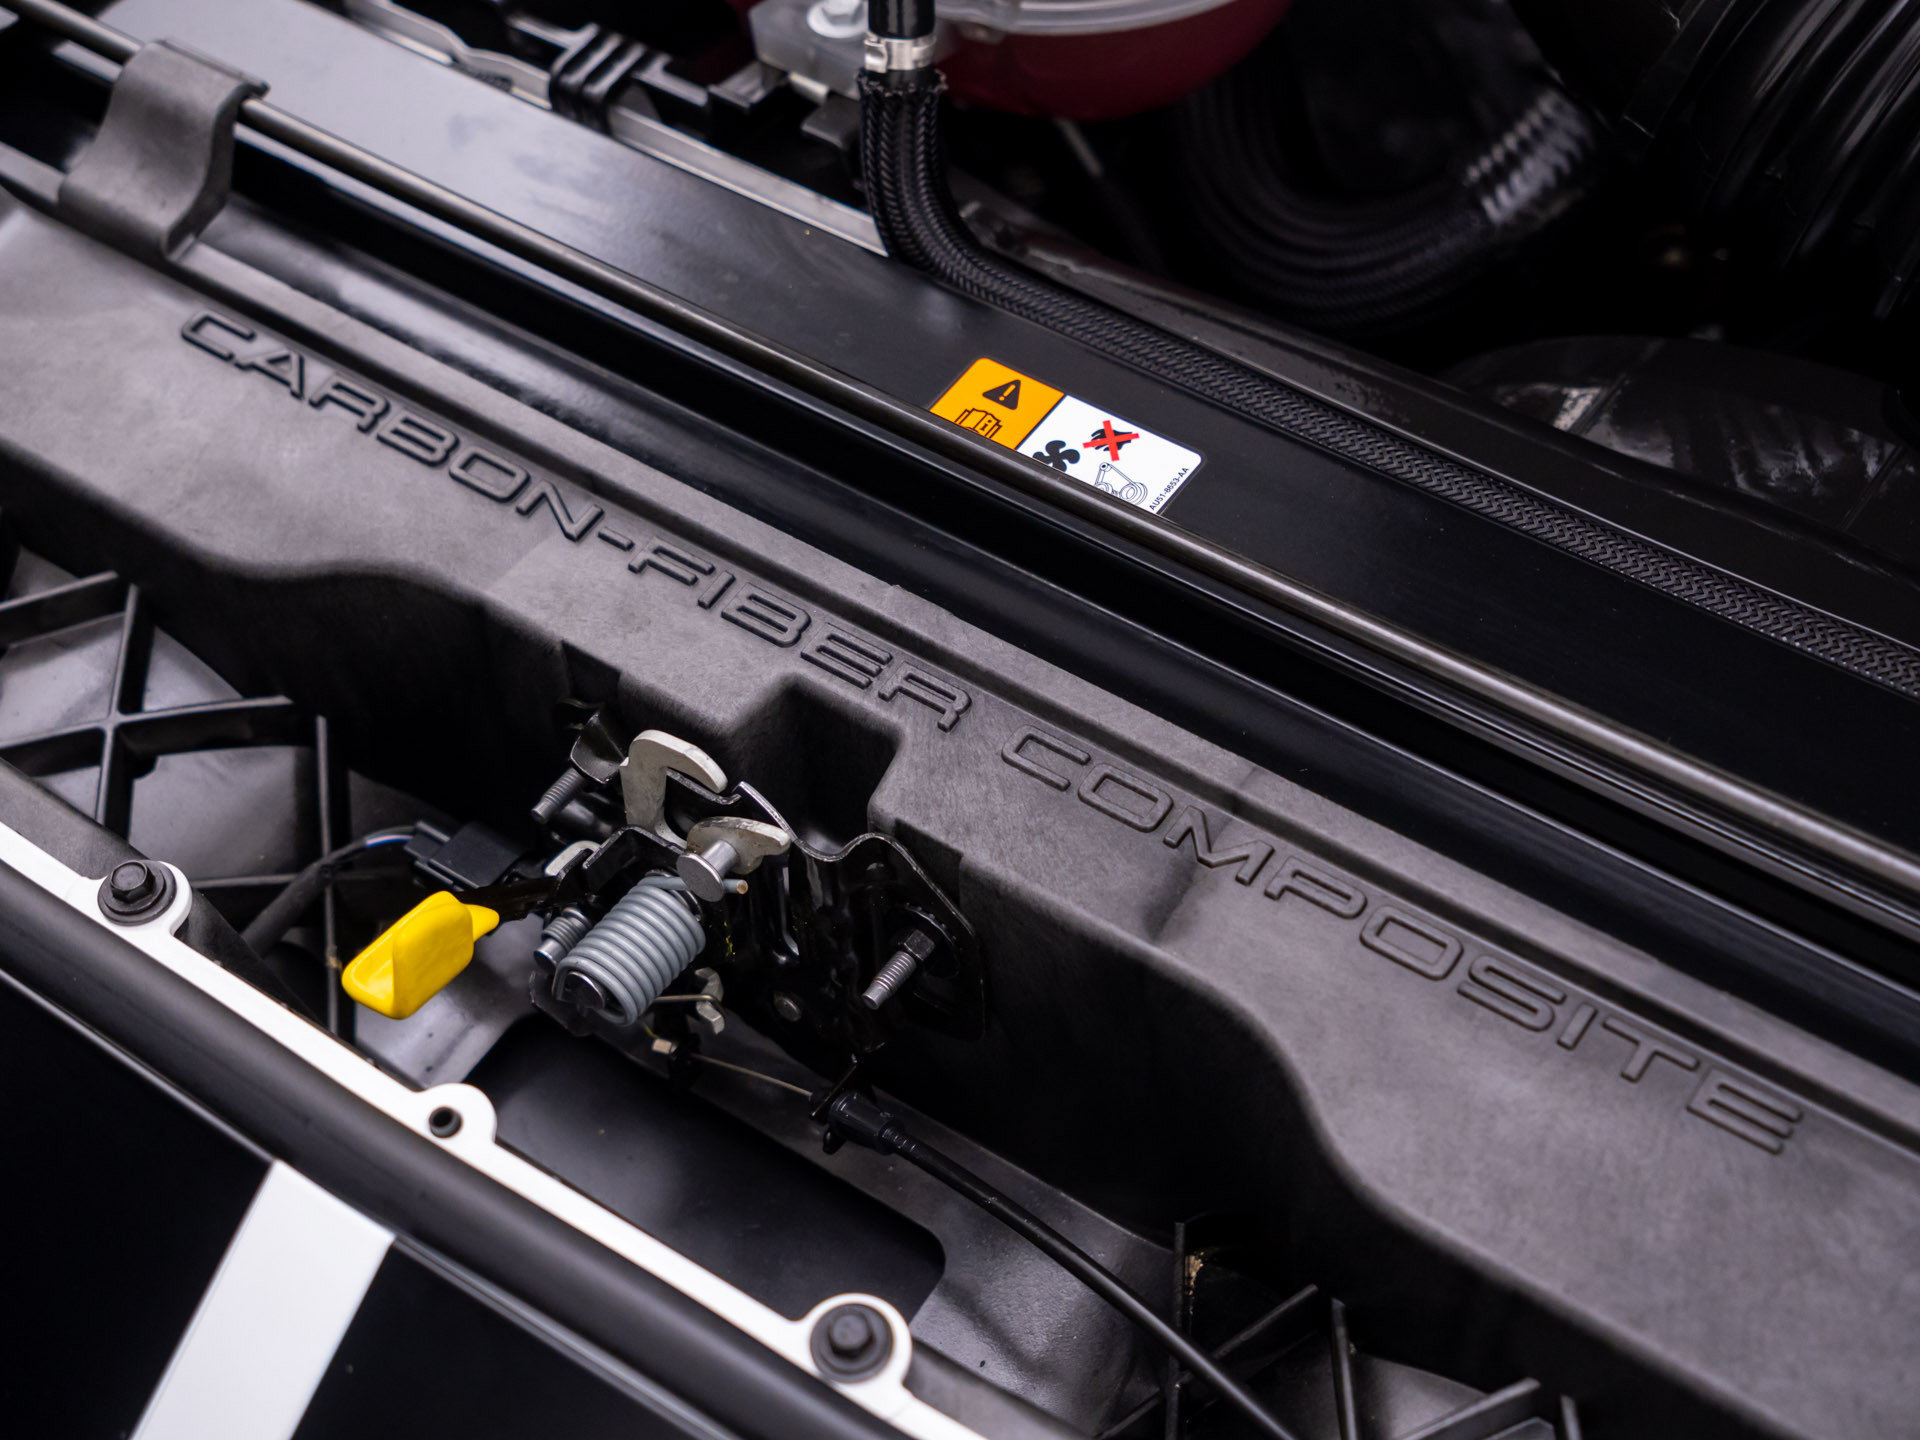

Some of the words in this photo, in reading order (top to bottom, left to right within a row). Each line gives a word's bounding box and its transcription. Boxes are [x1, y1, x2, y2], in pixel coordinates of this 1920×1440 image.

[1149, 467, 1189, 510] AU51-8653-AA
[180, 309, 973, 734] CARBON-FIBER
[1001, 722, 1805, 1155] COMPOSITE
